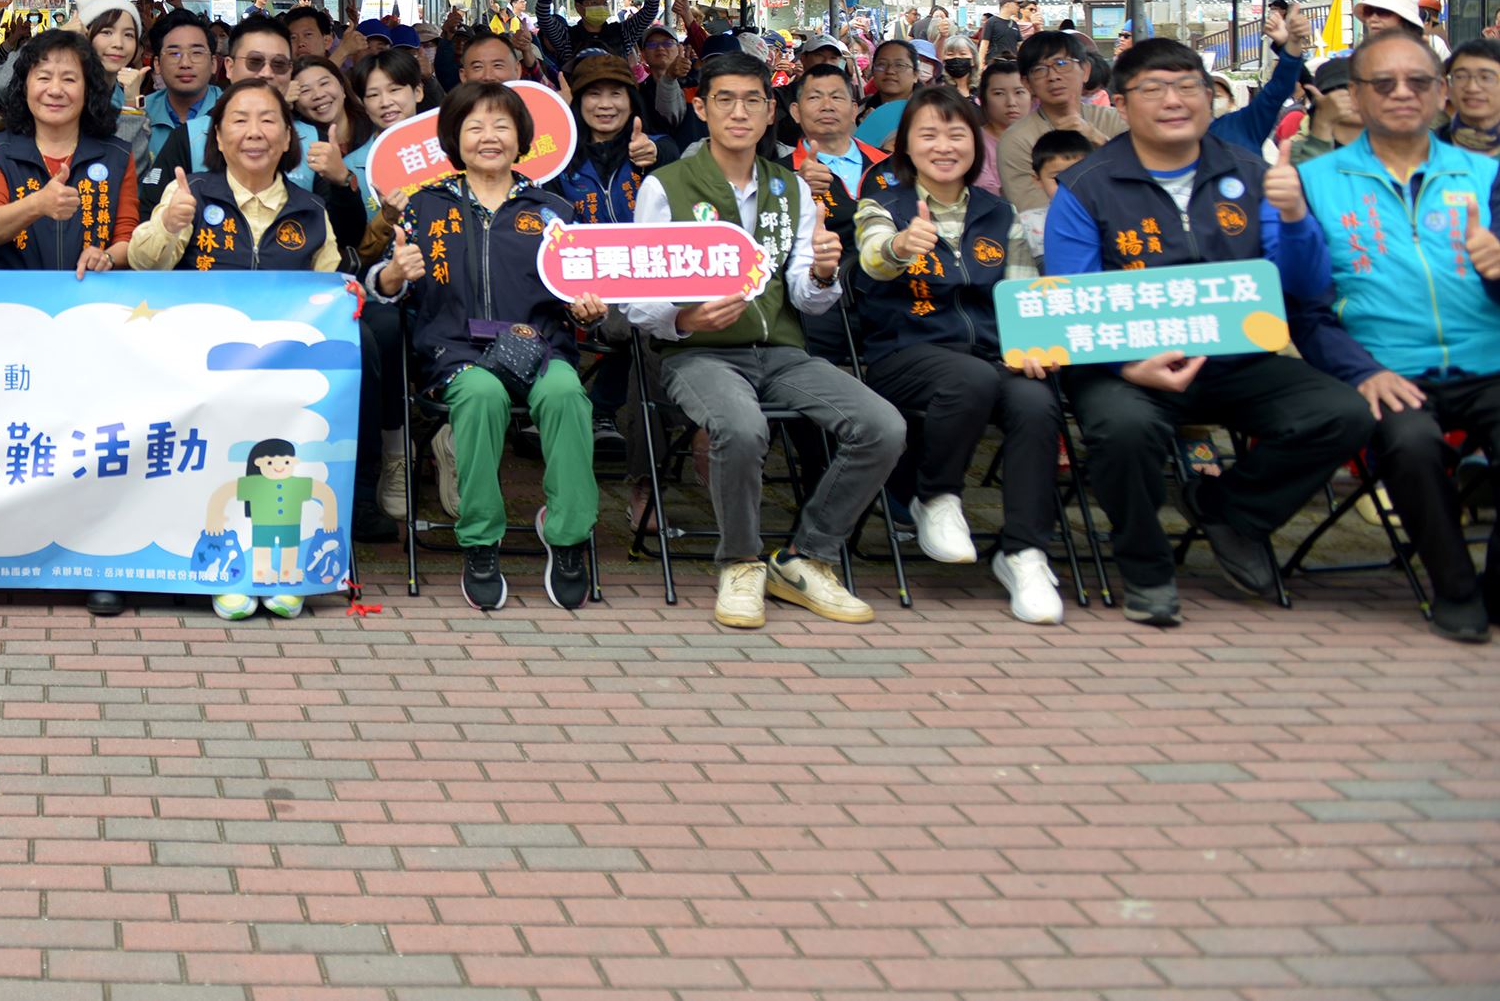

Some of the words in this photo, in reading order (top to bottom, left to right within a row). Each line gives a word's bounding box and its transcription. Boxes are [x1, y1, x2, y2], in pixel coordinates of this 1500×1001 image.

[222, 218, 237, 251] 議員
[448, 207, 464, 234] 議員
[1140, 217, 1162, 254] 議員
[427, 218, 450, 285] 廖英利
[559, 244, 741, 280] 苗栗縣政府
[1014, 274, 1262, 318] 苗栗好青年勞工及
[1065, 314, 1221, 353] 青年服務讚
